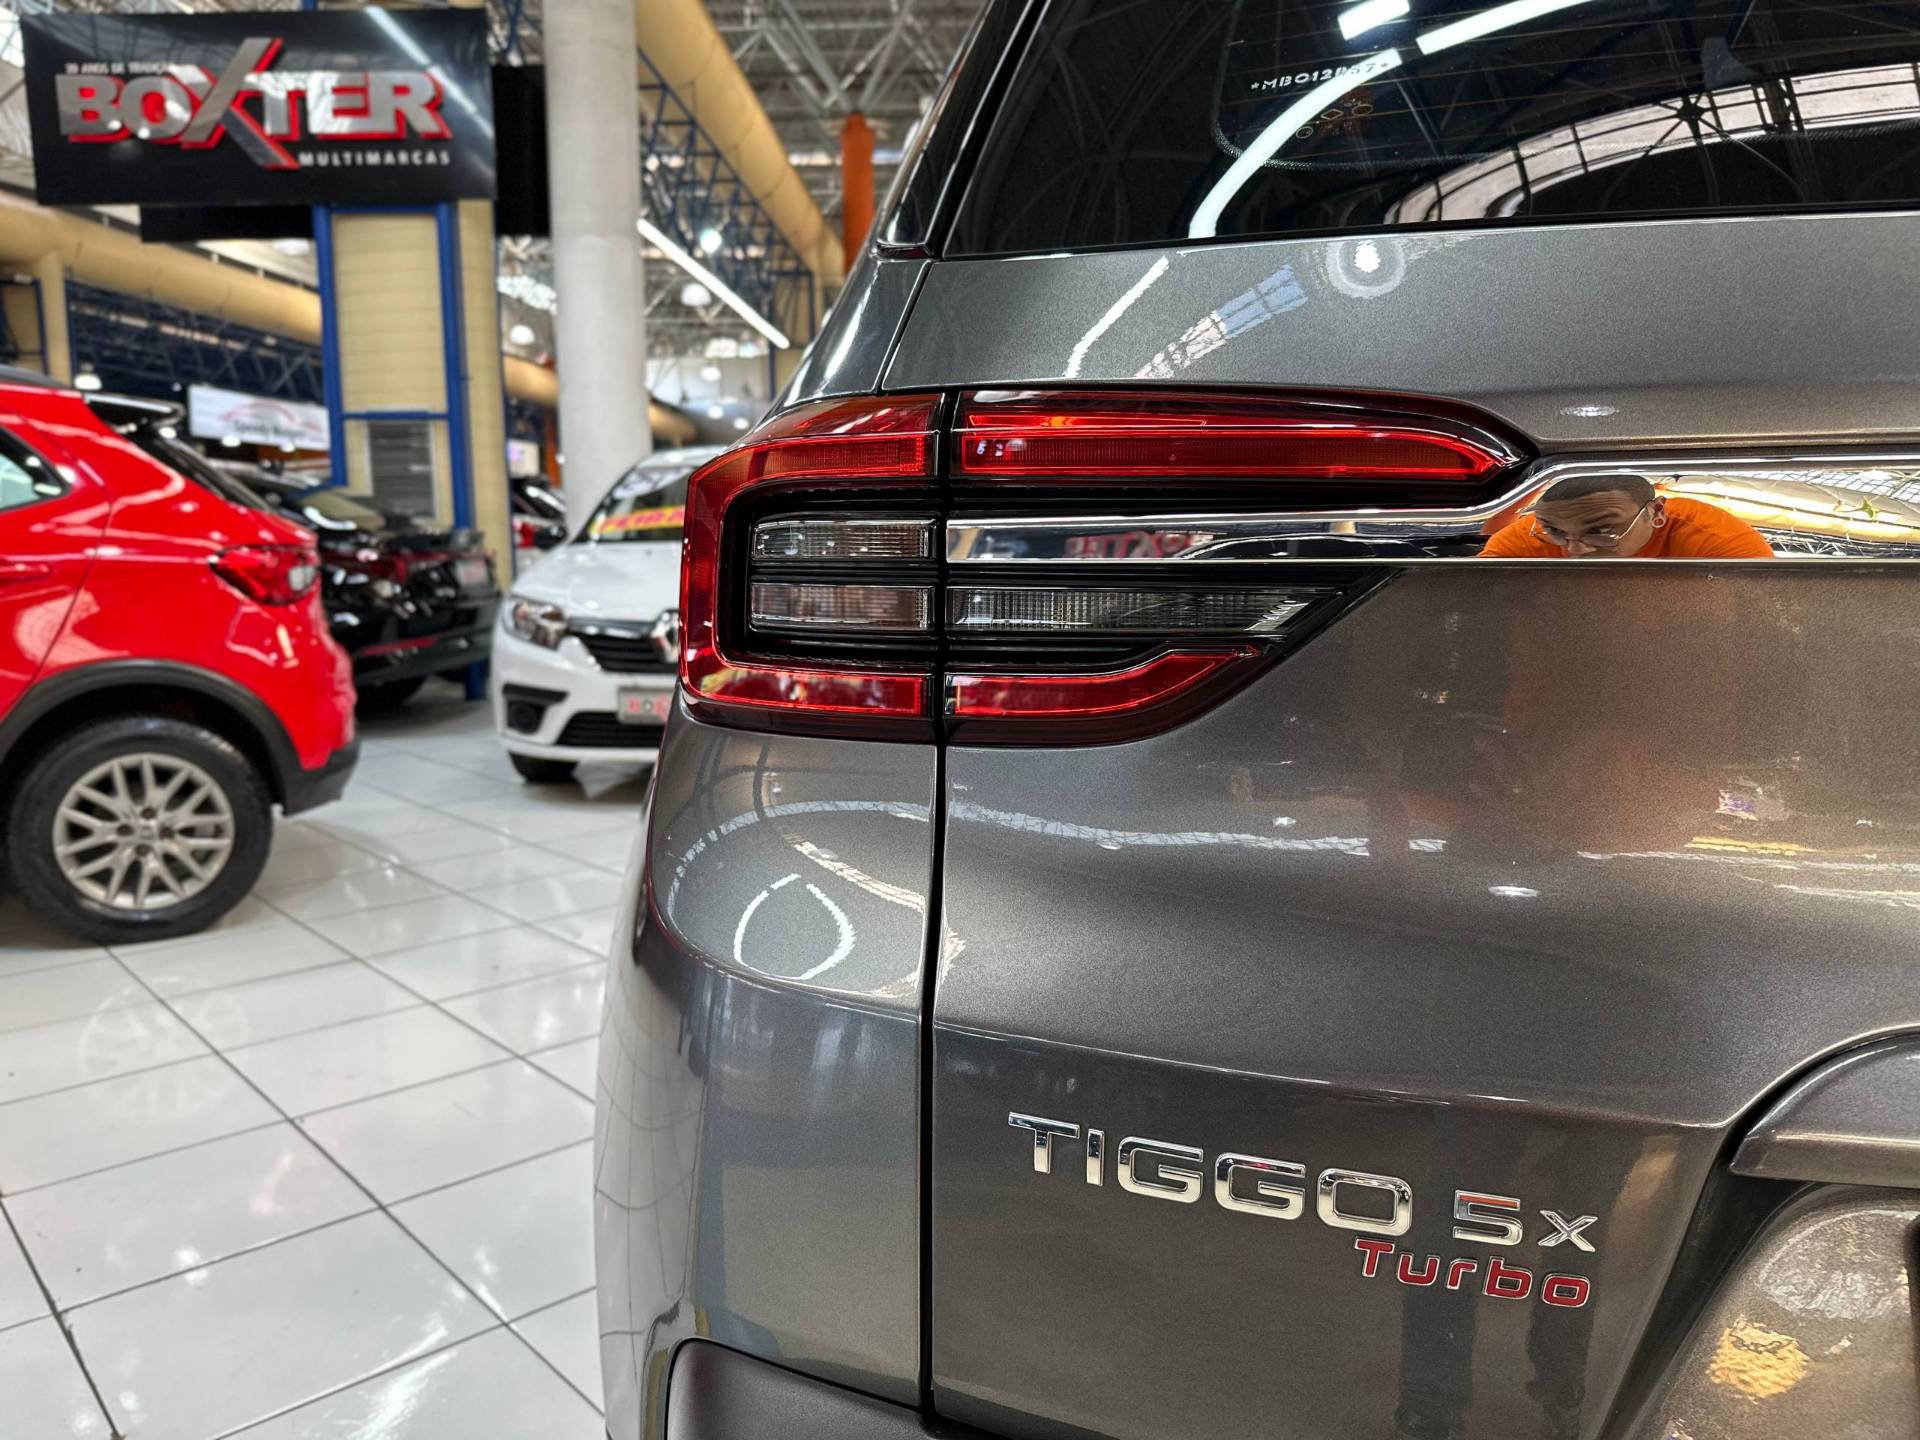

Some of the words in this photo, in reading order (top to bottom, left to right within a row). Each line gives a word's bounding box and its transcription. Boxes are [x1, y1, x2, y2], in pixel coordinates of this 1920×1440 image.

[55, 37, 452, 169] BOXTER
[298, 151, 450, 167] MULTIMARCAS
[1008, 1112, 1414, 1236] TIGGO
[1355, 1237, 1592, 1308] Turbo
